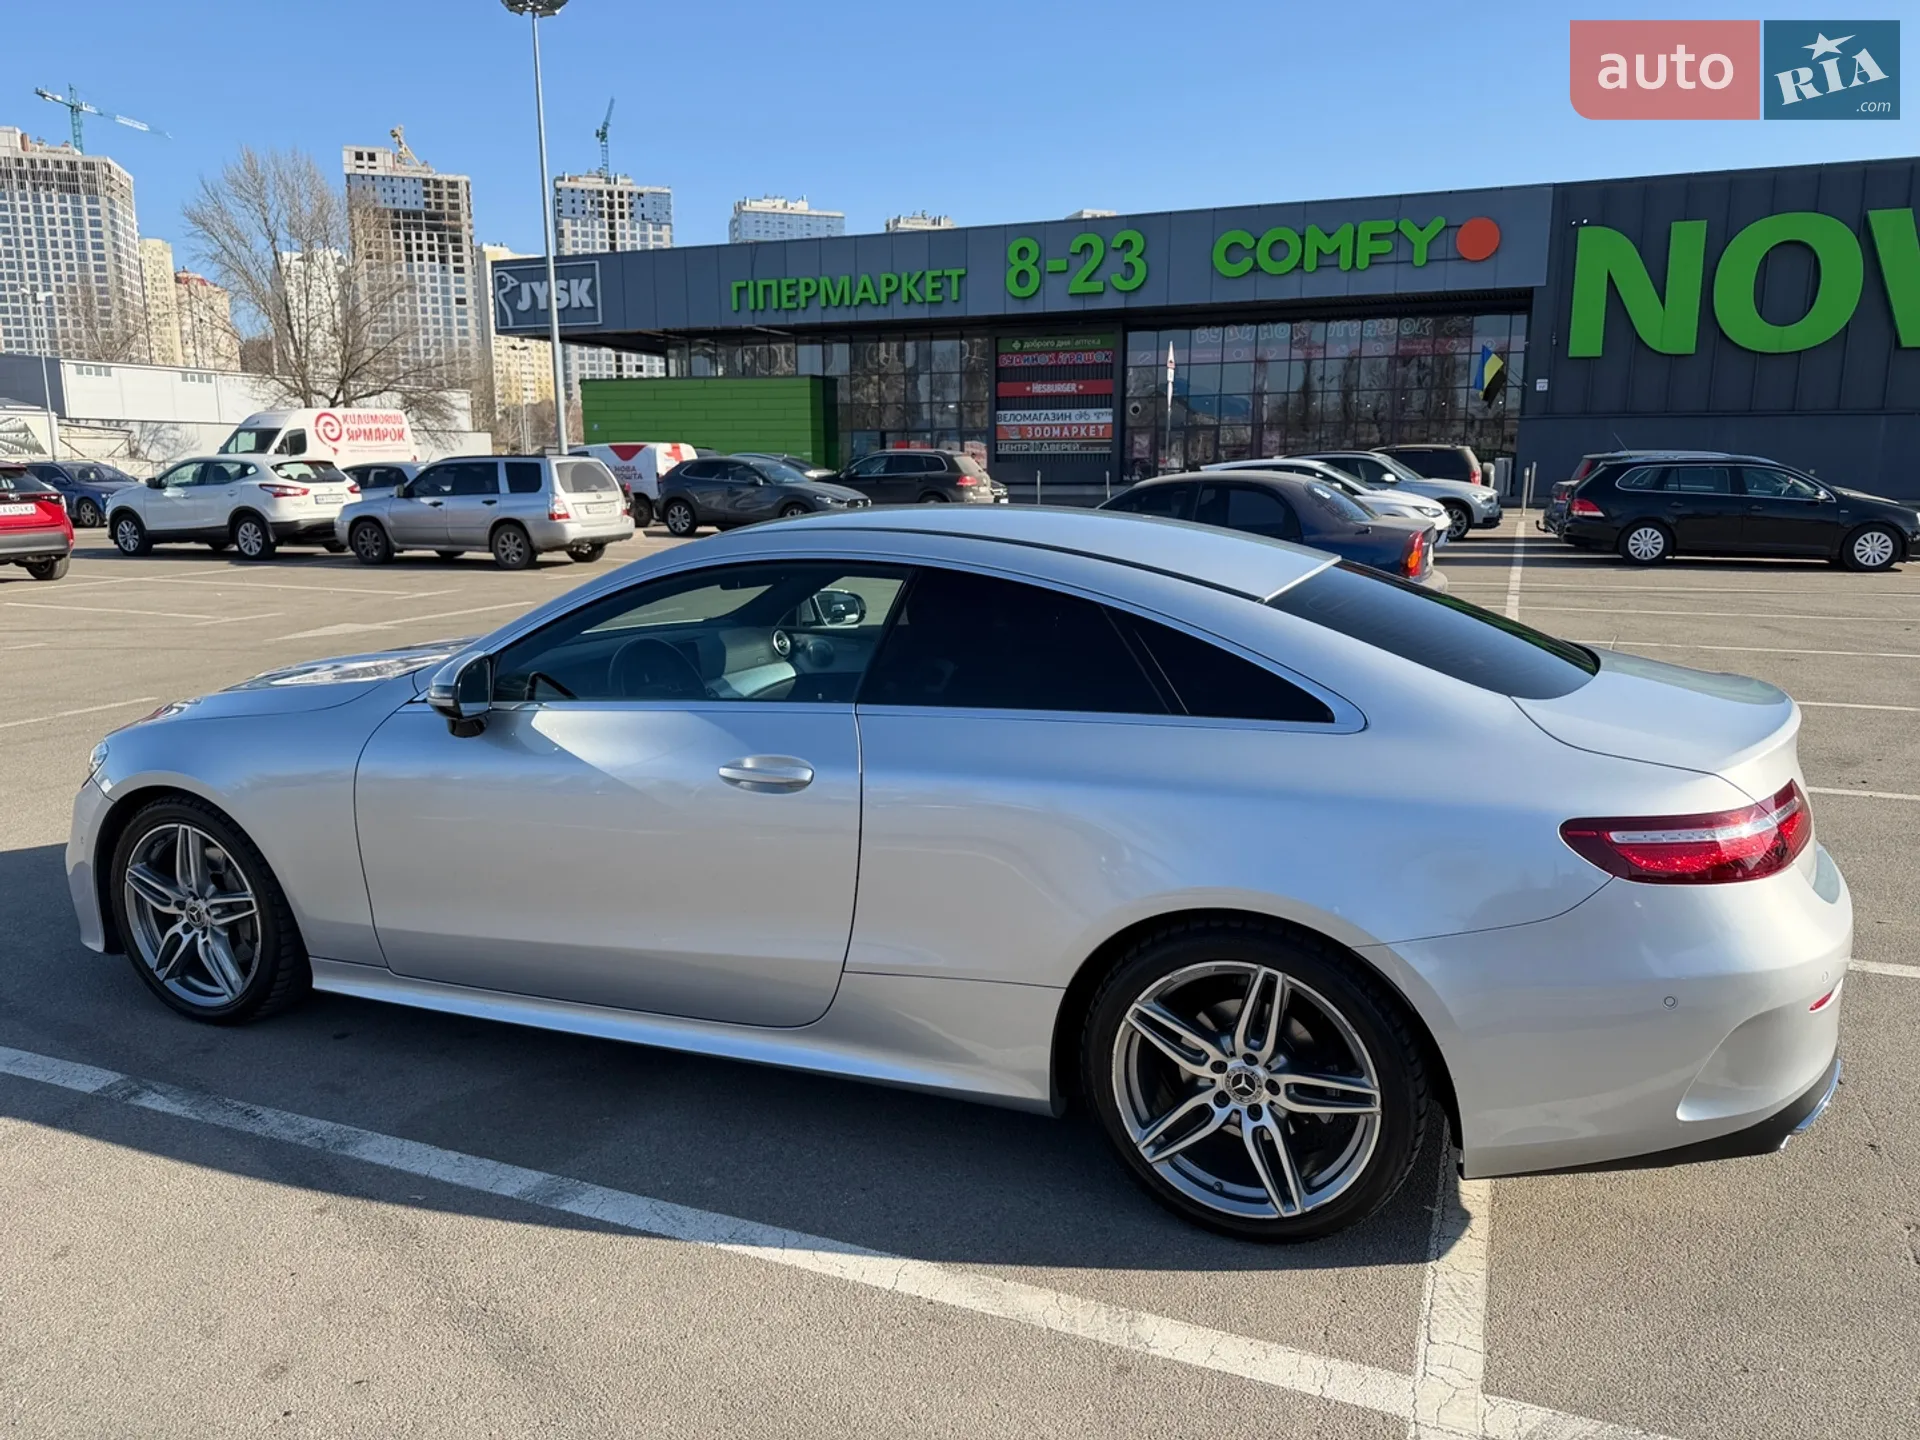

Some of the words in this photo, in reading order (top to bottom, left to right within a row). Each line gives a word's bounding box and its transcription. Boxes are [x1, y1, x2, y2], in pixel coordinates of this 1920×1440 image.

[1005, 229, 1147, 298] 8-23
[1212, 215, 1446, 278] COMFY
[516, 277, 595, 311] JYSK
[731, 267, 966, 312] ГІПЕРМАРКЕТ
[997, 411, 1072, 423] ВЕЛОМАГАЗИН
[1026, 425, 1106, 438] ЗООМАРКЕТ
[346, 427, 406, 442] ЯРМАРОК
